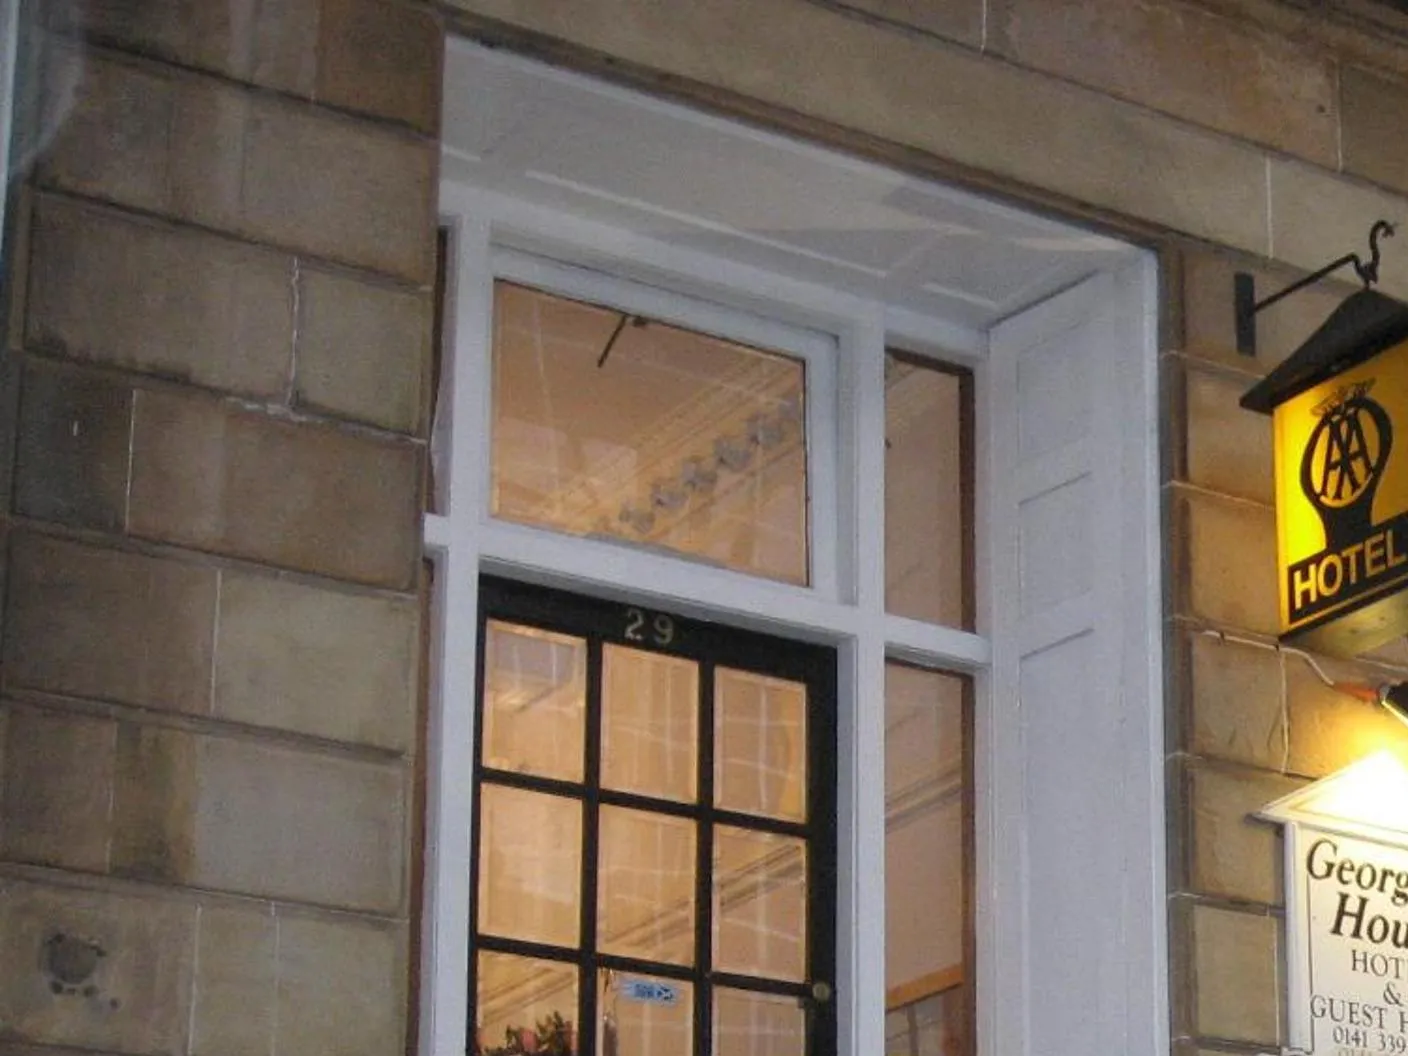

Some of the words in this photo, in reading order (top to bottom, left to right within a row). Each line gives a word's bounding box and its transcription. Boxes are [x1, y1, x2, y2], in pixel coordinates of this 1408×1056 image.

[1292, 528, 1408, 610] HOTEL
[623, 607, 674, 645] 29
[1310, 994, 1388, 1030] GUEST
[1382, 981, 1404, 1007] &
[1332, 1025, 1368, 1049] 0141
[1378, 1032, 1406, 1054] 339
